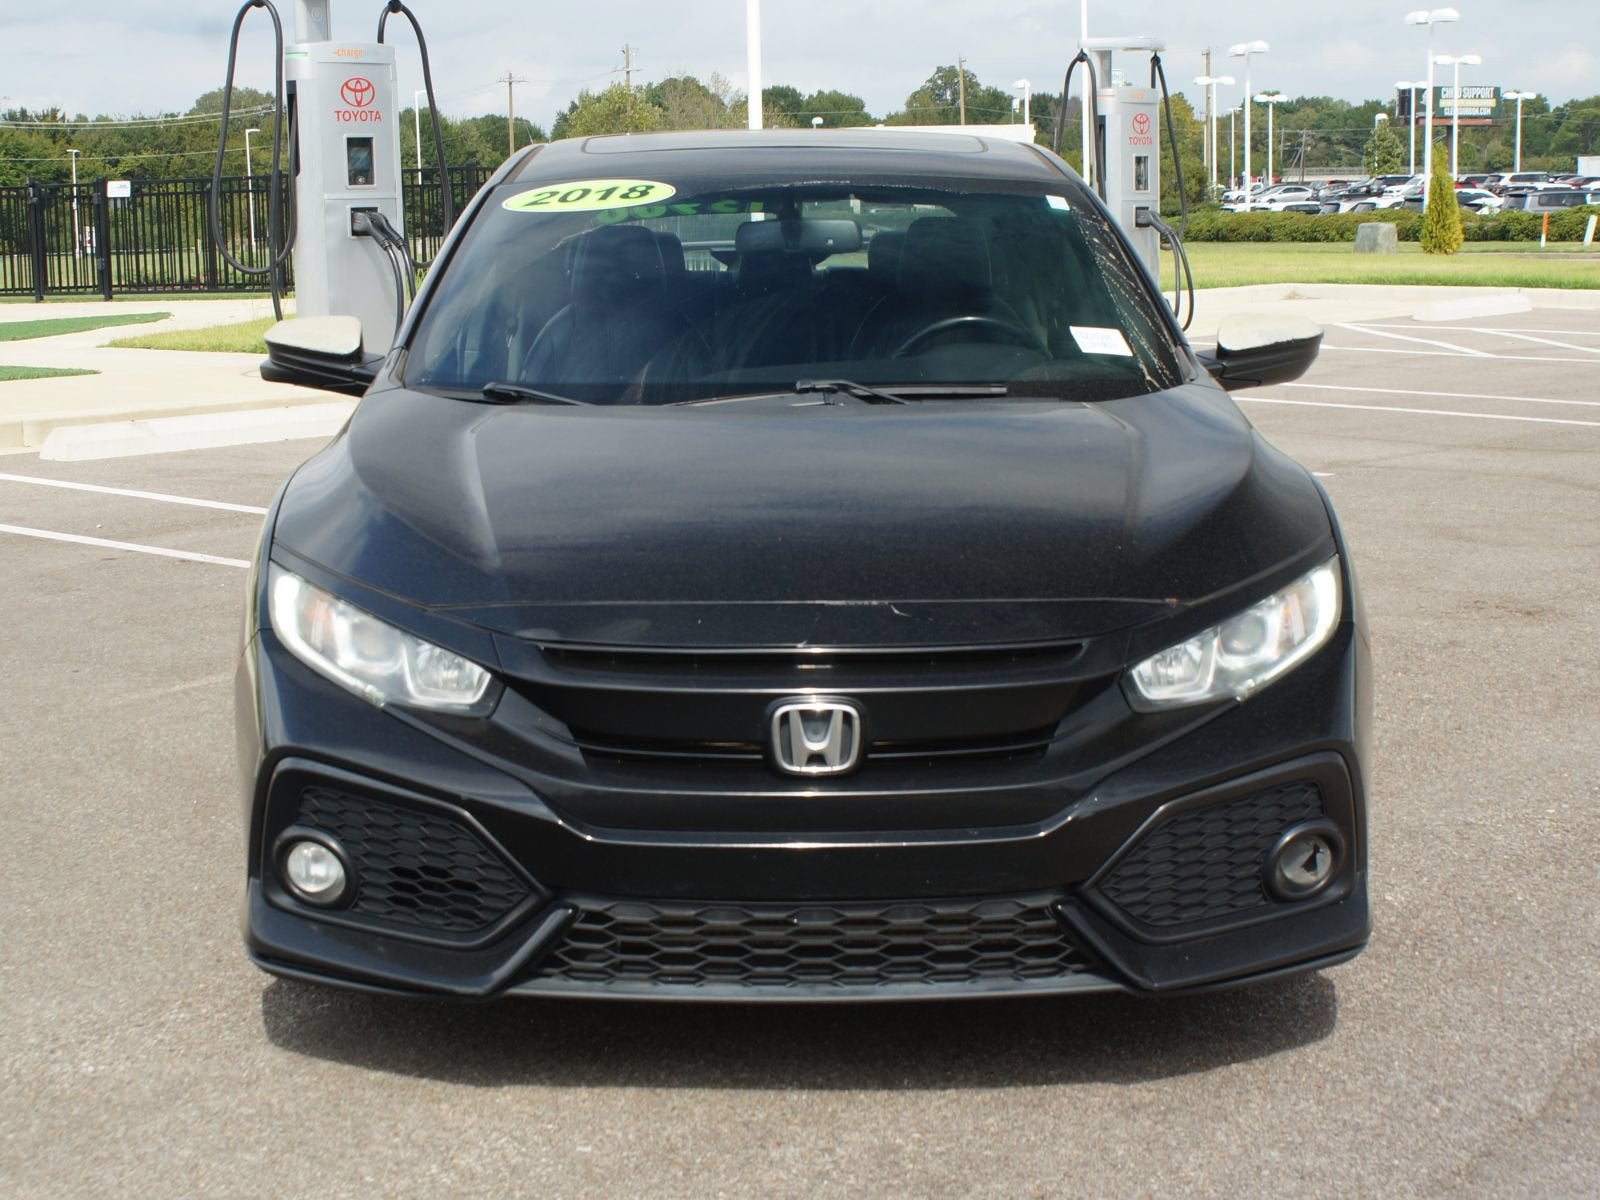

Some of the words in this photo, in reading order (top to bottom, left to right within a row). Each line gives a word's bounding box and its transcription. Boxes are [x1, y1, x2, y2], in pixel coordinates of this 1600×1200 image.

[1462, 87, 1494, 99] SUPPORT
[335, 110, 382, 122] TOYOTA
[1129, 136, 1152, 145] TOYOTA
[521, 185, 655, 208] 2018
